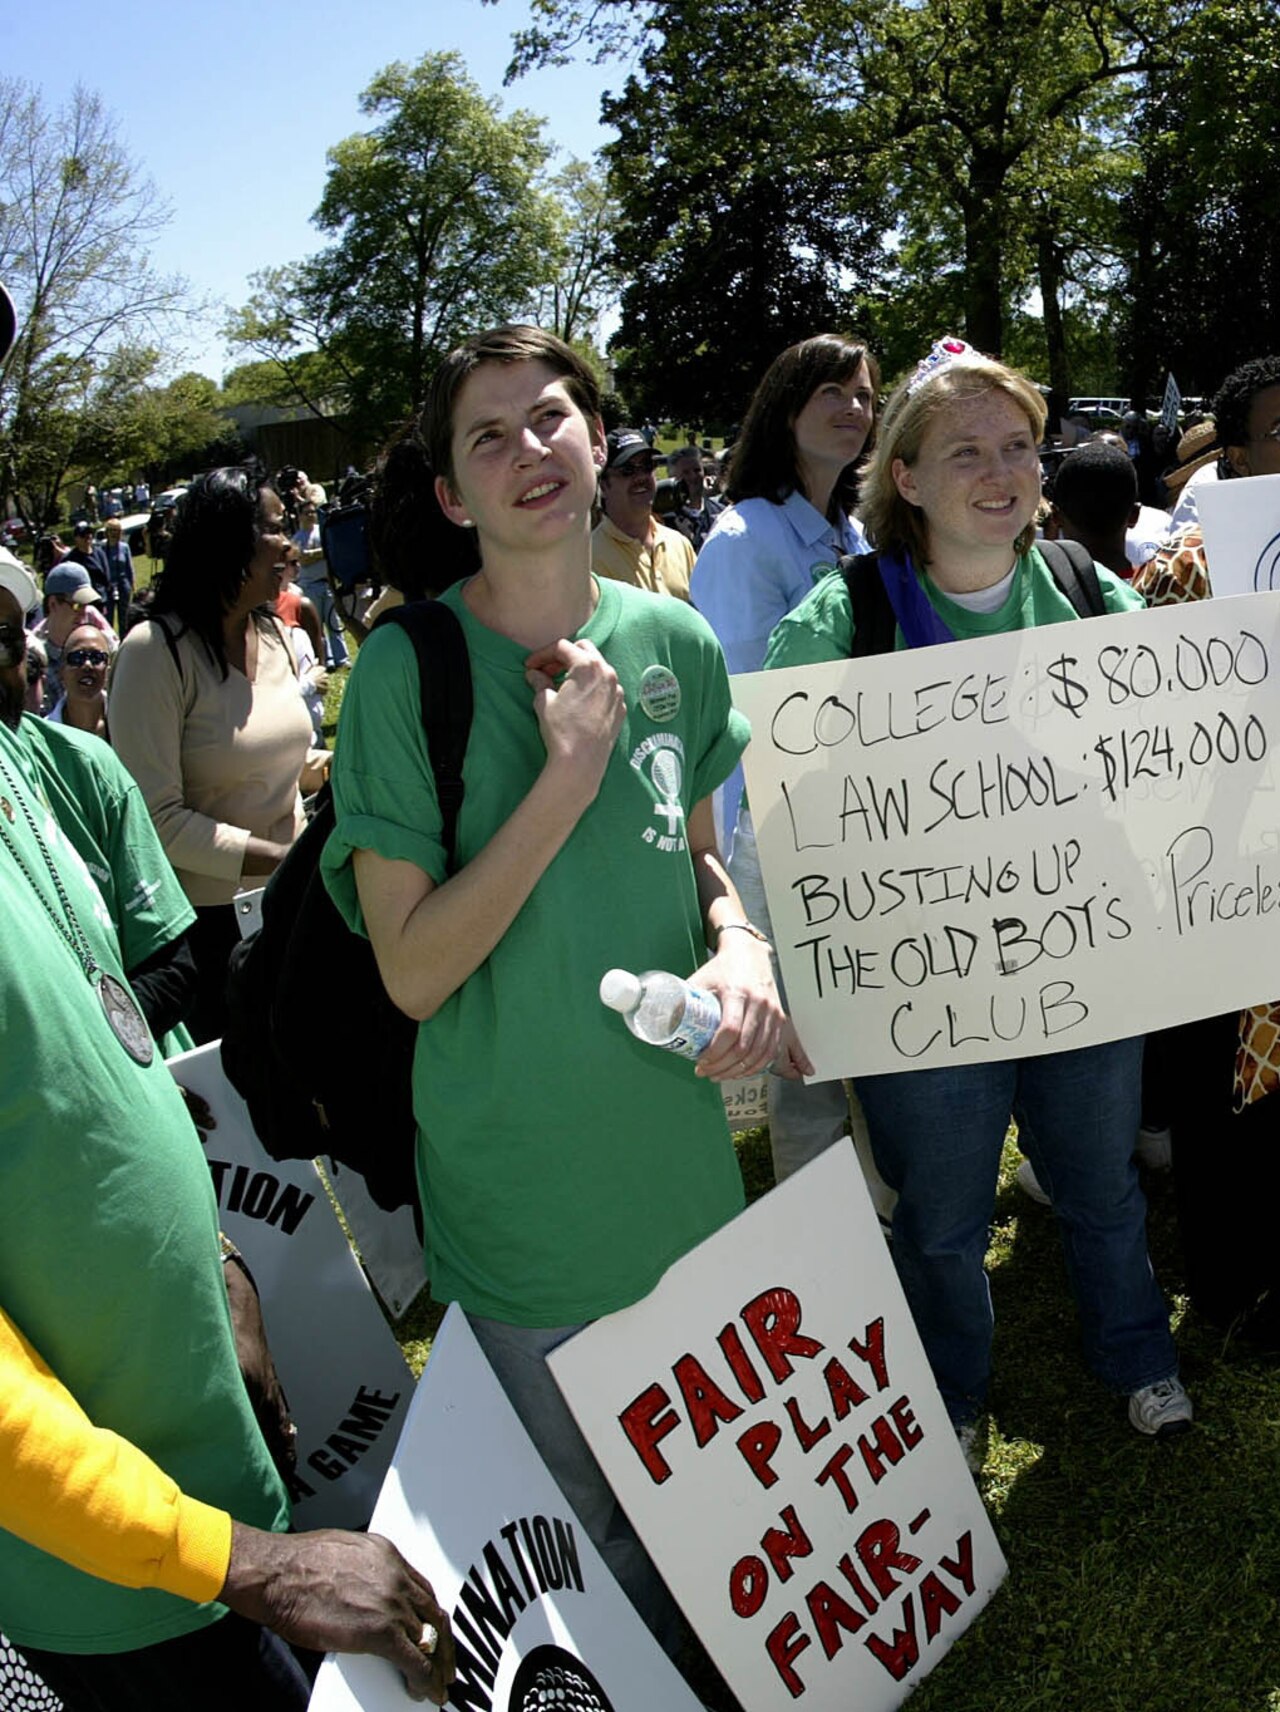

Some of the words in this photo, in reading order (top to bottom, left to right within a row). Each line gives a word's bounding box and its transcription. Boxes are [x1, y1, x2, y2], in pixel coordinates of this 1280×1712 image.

[641, 826, 657, 844] IS
[781, 775, 909, 852] LAW
[1094, 712, 1267, 801] $124,000
[791, 856, 1020, 927] BUSTING
[1032, 838, 1082, 895] UP
[795, 935, 885, 997] THE
[891, 924, 978, 987] OLD
[890, 981, 1089, 1058] CLUB
[306, 1385, 401, 1481] GAME
[617, 1287, 826, 1485] FAIR
[735, 1316, 890, 1489] PLAY
[729, 1504, 814, 1618] ON
[815, 1395, 925, 1514] THE
[765, 1508, 932, 1699] FAIR-
[863, 1530, 976, 1681] WAY
